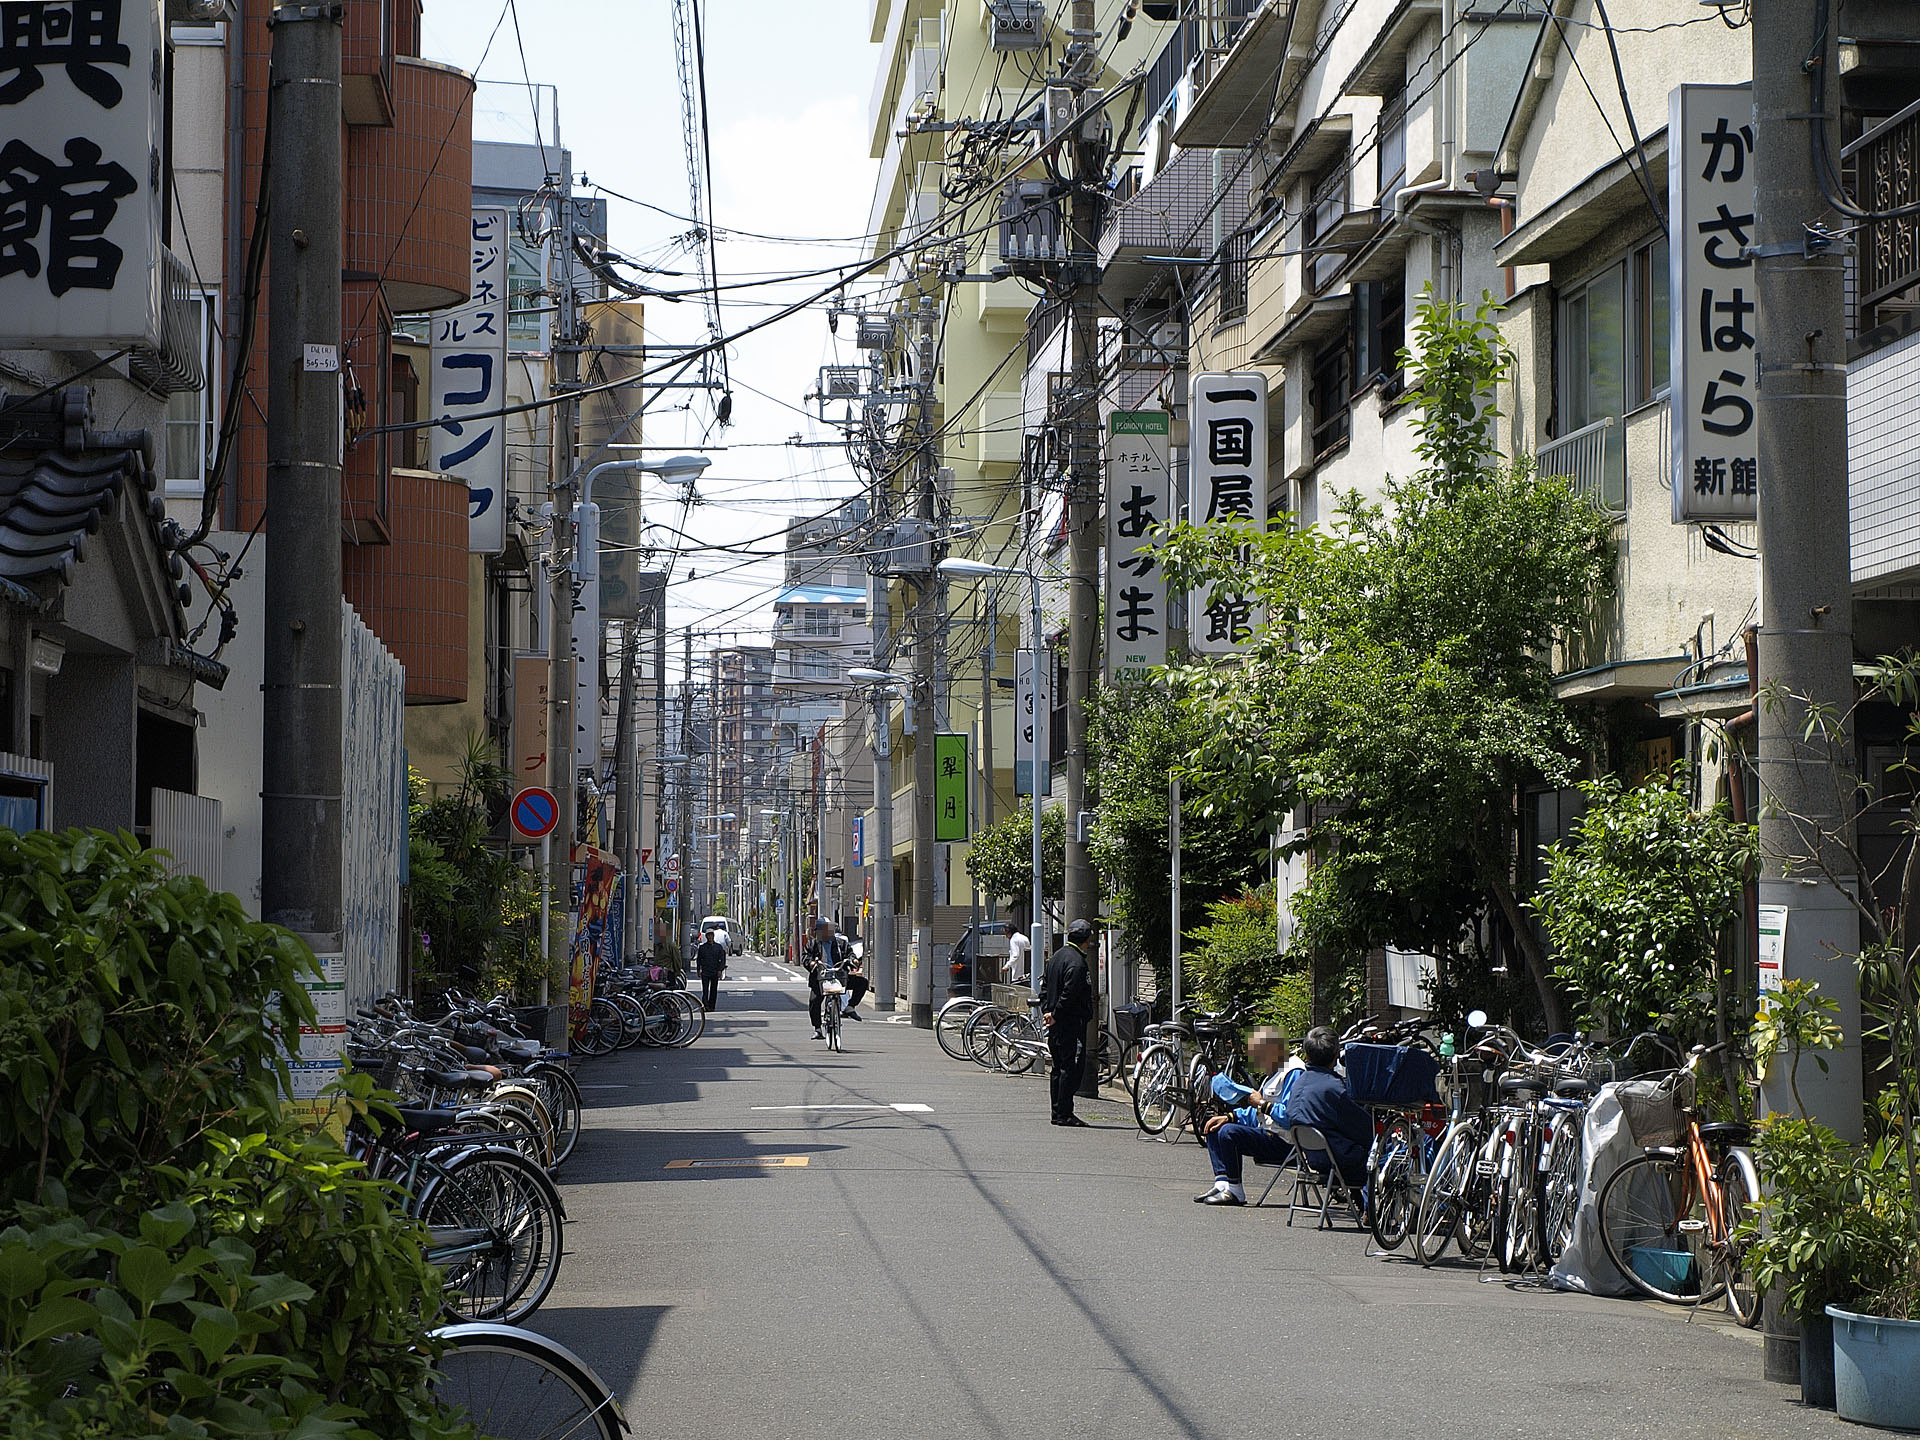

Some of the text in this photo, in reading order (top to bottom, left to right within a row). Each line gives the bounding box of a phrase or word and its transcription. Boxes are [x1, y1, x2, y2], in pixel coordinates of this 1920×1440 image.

[471, 215, 499, 336] ビジネス
[1697, 116, 1756, 438] かさはら
[1116, 422, 1164, 431] ECONOMY HOTEL
[1117, 452, 1152, 463] ホテル
[1128, 464, 1161, 473] ニュー
[1693, 455, 1757, 497] 新館
[1125, 655, 1147, 663] NEW
[1114, 667, 1154, 682] AZU
[940, 755, 962, 820] 翠月
